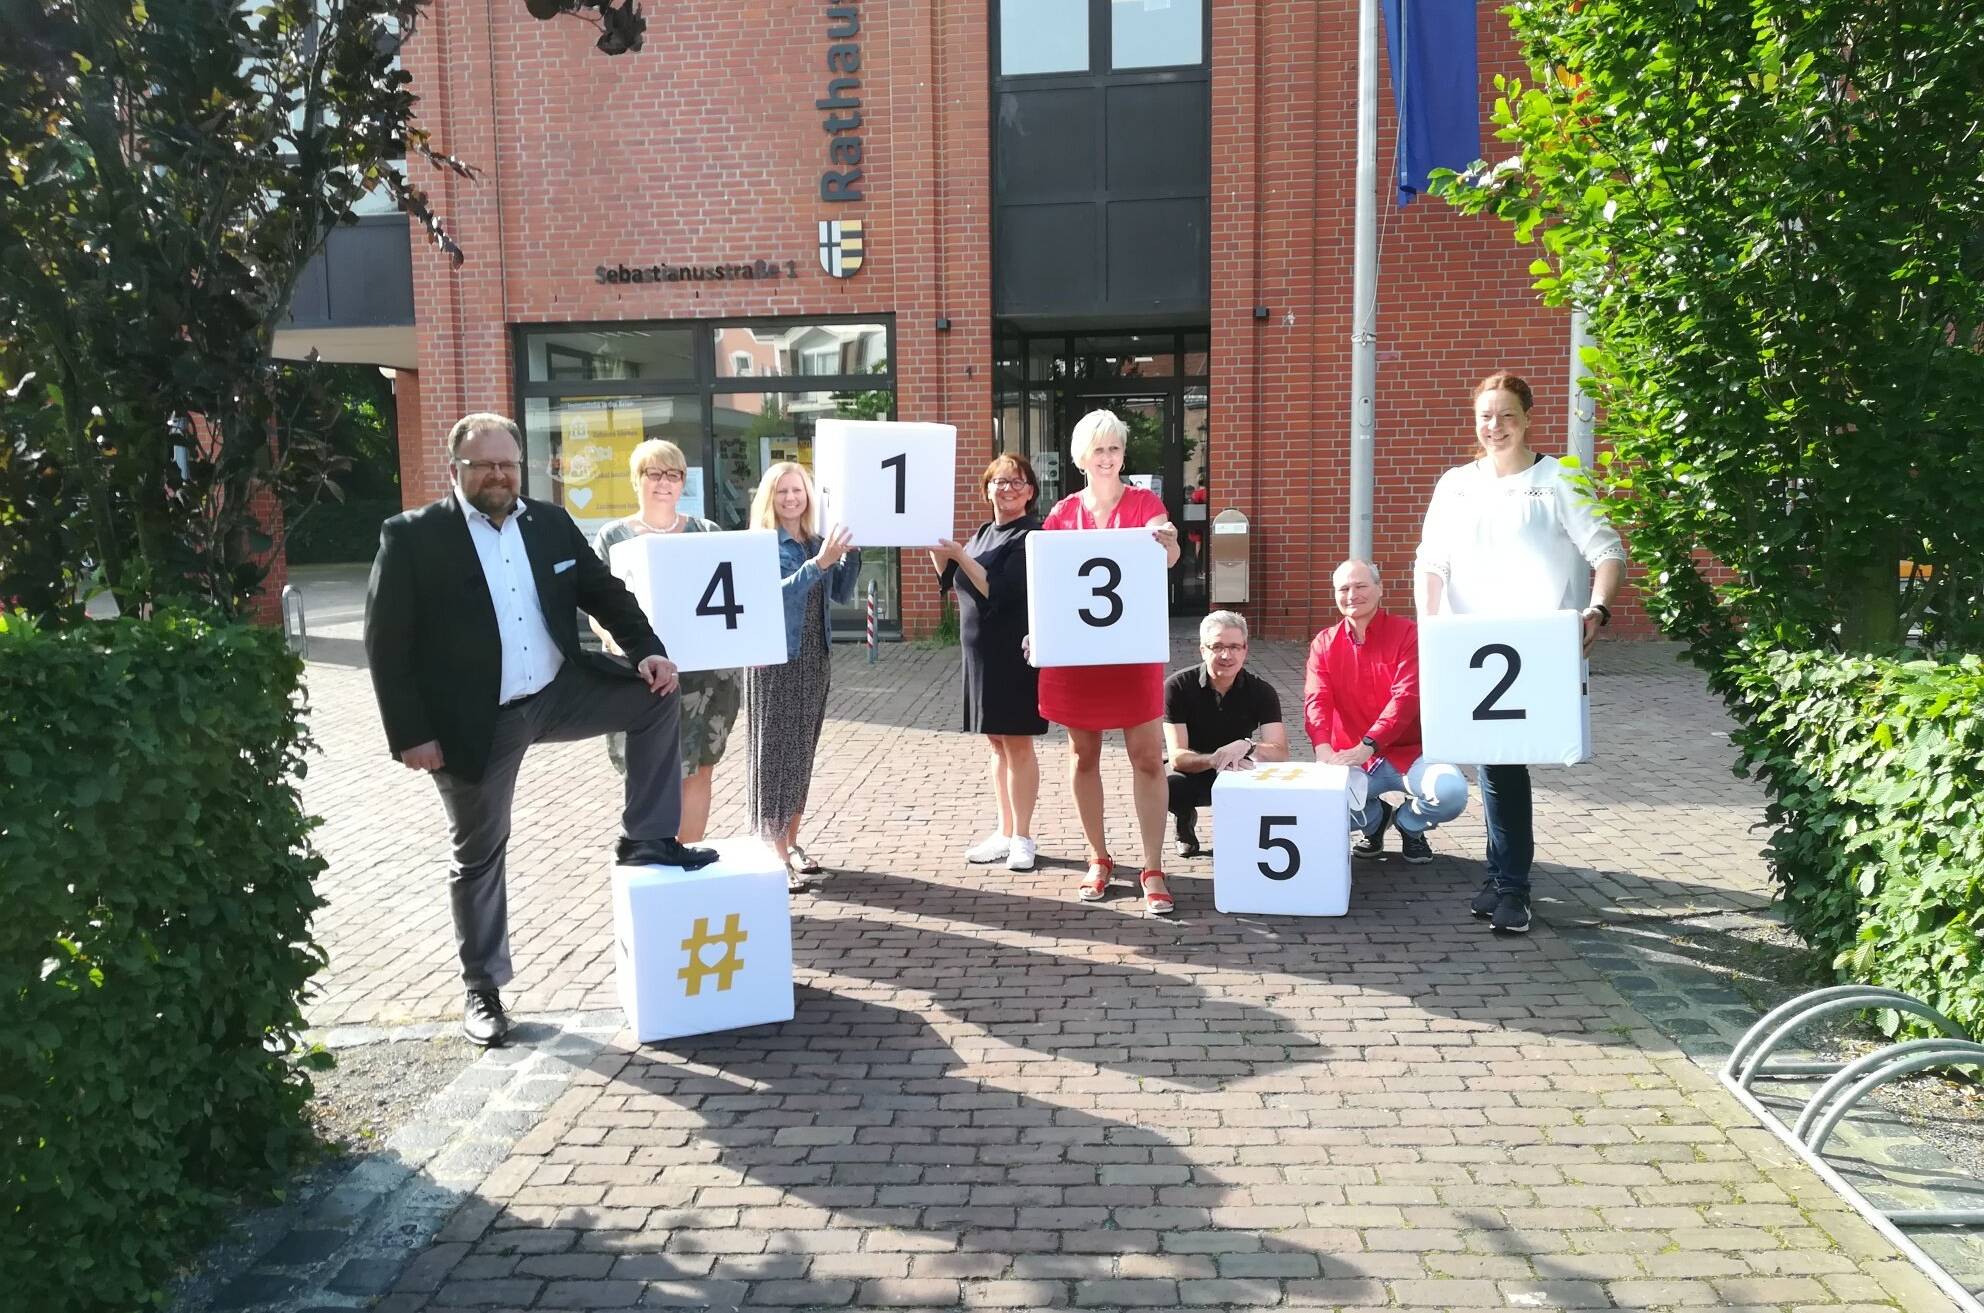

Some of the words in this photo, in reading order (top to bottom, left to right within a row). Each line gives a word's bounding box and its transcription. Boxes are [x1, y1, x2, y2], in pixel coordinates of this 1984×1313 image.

[816, 0, 863, 202] Rathau
[786, 260, 798, 279] 1
[881, 452, 906, 514] 1
[695, 561, 745, 630] 4
[1077, 557, 1124, 628] 3
[1469, 643, 1527, 721] 2
[1256, 815, 1301, 881] 5
